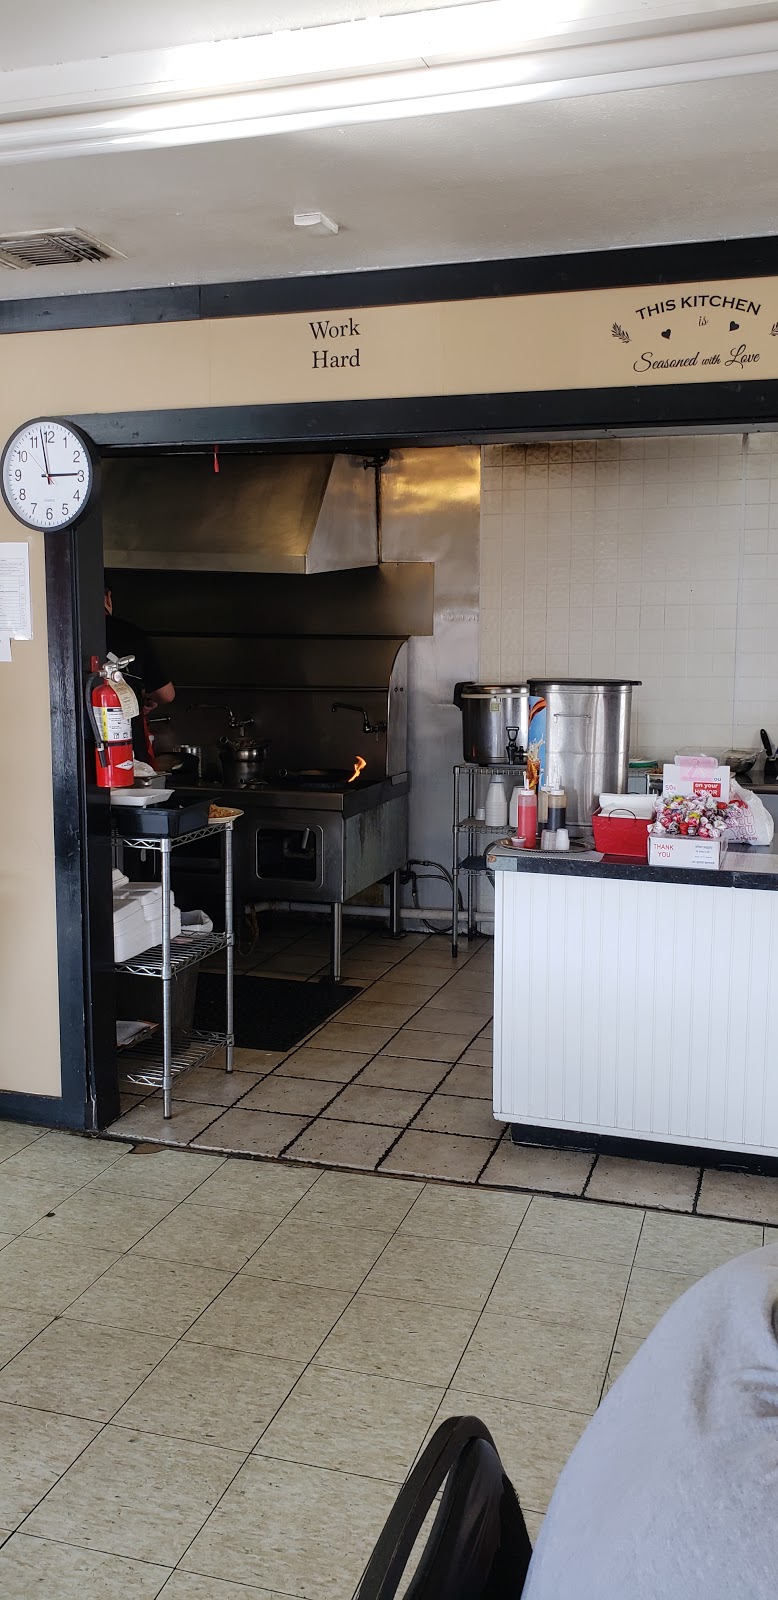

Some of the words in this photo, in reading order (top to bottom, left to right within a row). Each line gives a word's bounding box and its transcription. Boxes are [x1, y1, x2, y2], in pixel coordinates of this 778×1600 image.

[635, 299, 676, 320] THIS
[681, 295, 762, 316] KITCHEN
[698, 315, 709, 327] is
[308, 317, 361, 340] Work
[311, 348, 361, 369] Hard
[633, 351, 700, 373] Seasoned
[701, 354, 721, 366] with
[724, 344, 760, 369] Love
[30, 436, 39, 449] 11
[44, 431, 55, 444] 12
[63, 436, 68, 449] 1
[17, 450, 28, 463] 10
[73, 450, 81, 463] 2
[14, 469, 22, 482] 9
[77, 469, 85, 483] 3
[19, 488, 27, 501] 8
[73, 489, 81, 502] 4
[30, 502, 38, 515] 7
[46, 507, 54, 521] 6
[61, 503, 69, 516] 5
